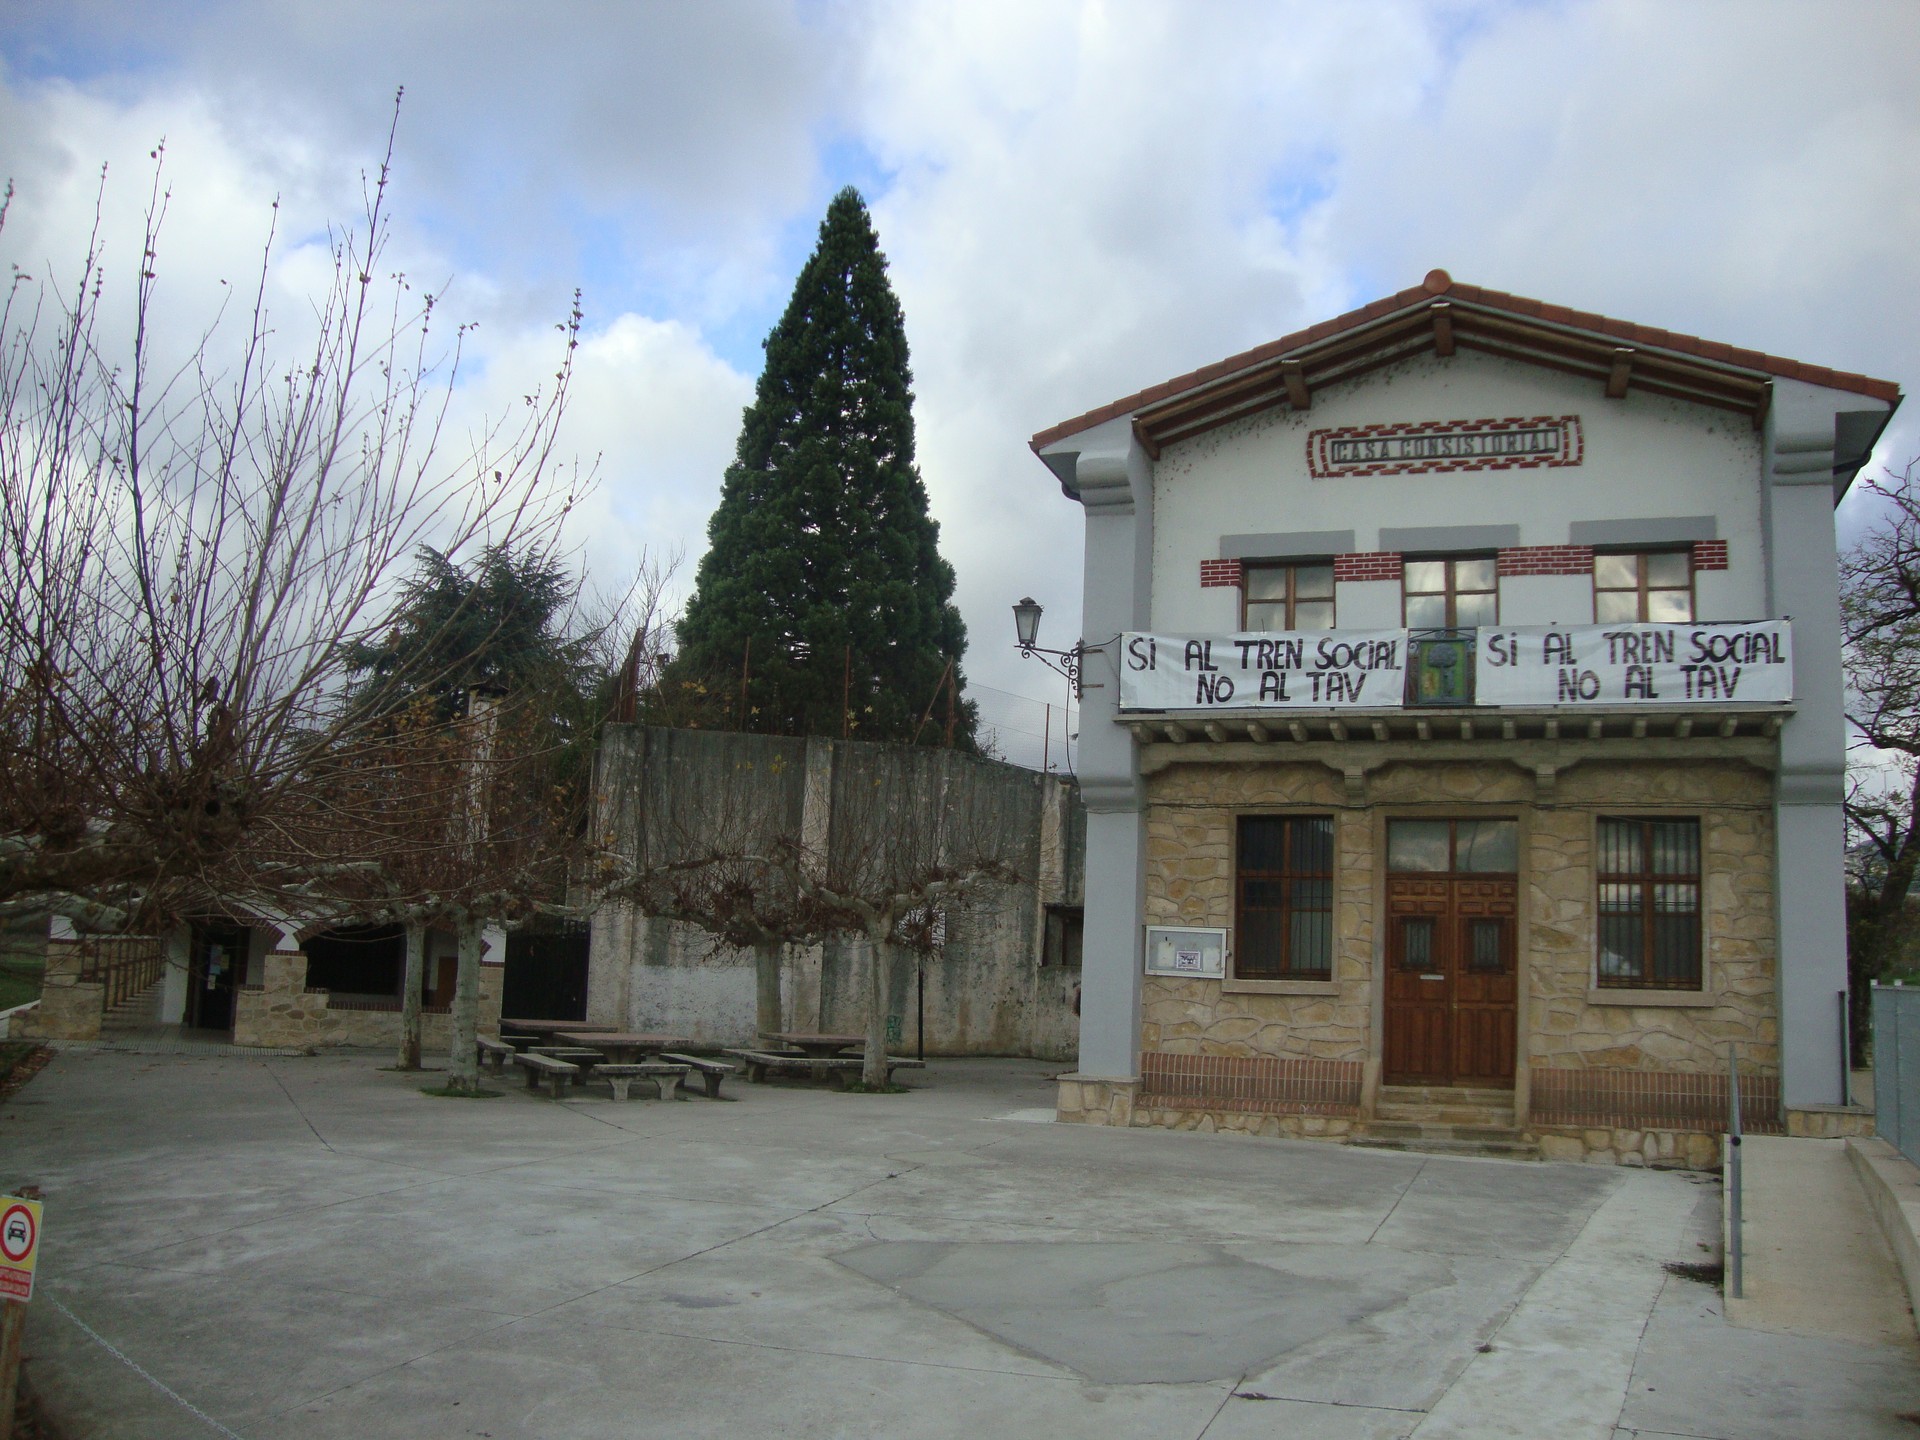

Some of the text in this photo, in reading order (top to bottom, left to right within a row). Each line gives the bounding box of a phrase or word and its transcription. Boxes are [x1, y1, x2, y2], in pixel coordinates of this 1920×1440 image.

[1337, 431, 1555, 460] CASA CONSISTORIAL
[1184, 639, 1219, 671] AL
[1234, 638, 1303, 670] TREN
[1543, 632, 1578, 665] AL
[1602, 629, 1675, 664] TREN
[1196, 671, 1367, 705] NO AL TAV
[1558, 664, 1742, 702] NO AL TAV
